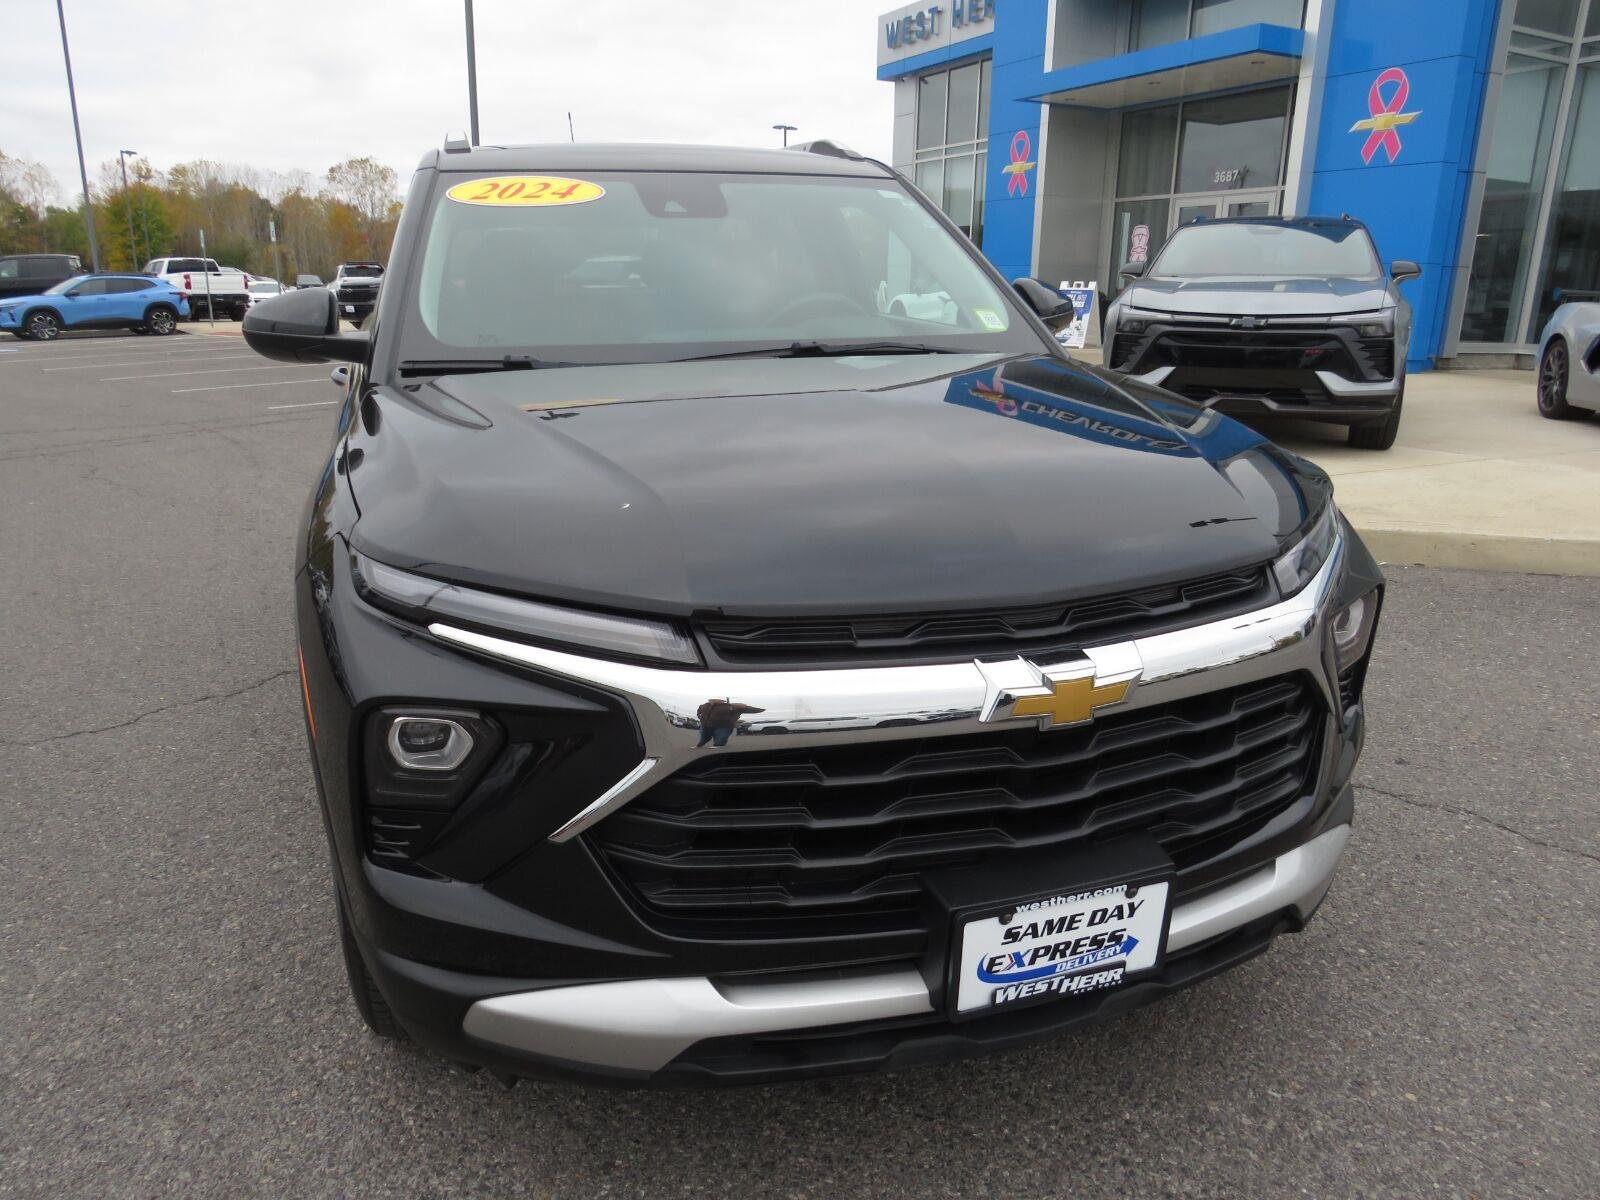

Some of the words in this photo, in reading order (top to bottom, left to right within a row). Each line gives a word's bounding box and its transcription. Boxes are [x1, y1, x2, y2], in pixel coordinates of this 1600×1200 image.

[886, 6, 942, 49] WEST
[470, 181, 582, 200] 2024
[1214, 169, 1239, 183] 3687
[1015, 884, 1128, 914] westherr.com
[1001, 912, 1084, 945] SAME
[1087, 899, 1145, 928] DAY
[985, 928, 1126, 974] EXPRESS
[1055, 944, 1123, 973] DELIVERY
